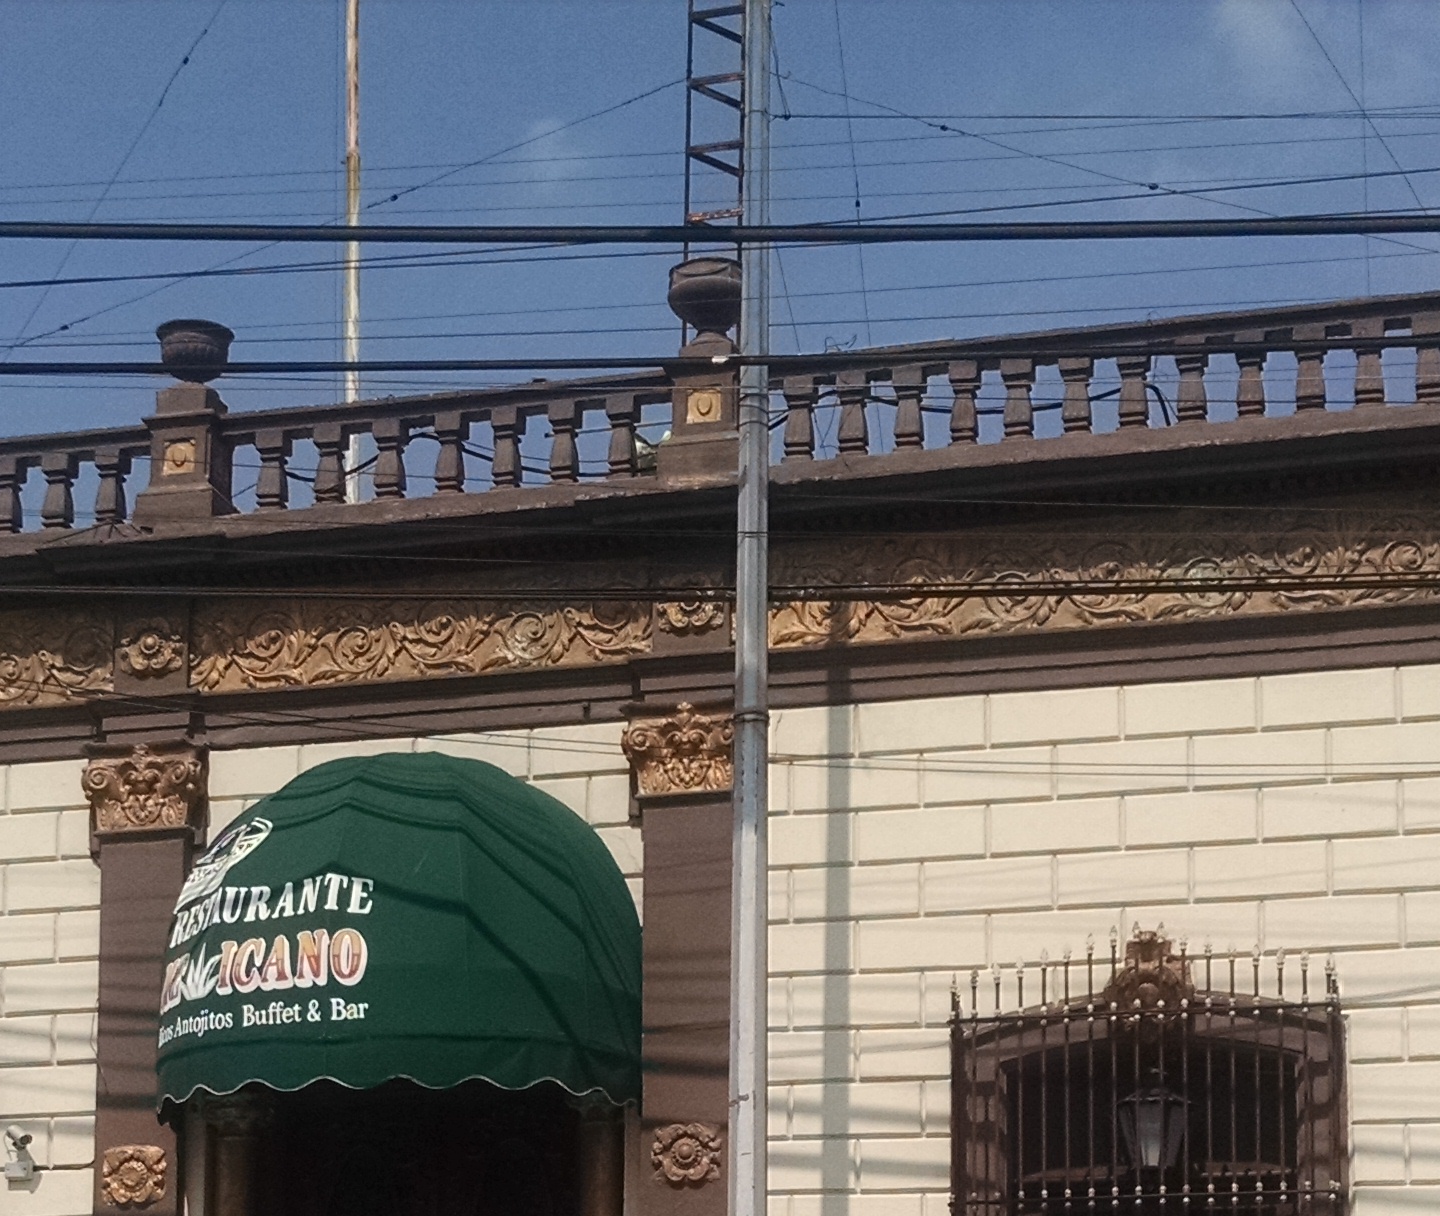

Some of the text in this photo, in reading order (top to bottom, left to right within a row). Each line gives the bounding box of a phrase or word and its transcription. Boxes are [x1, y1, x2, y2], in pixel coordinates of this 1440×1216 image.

[169, 872, 374, 948] RESTAURANTE
[174, 1008, 234, 1037] Antojitos
[242, 1002, 303, 1027] Buffet
[307, 999, 322, 1022] &
[330, 997, 369, 1021] Bar
